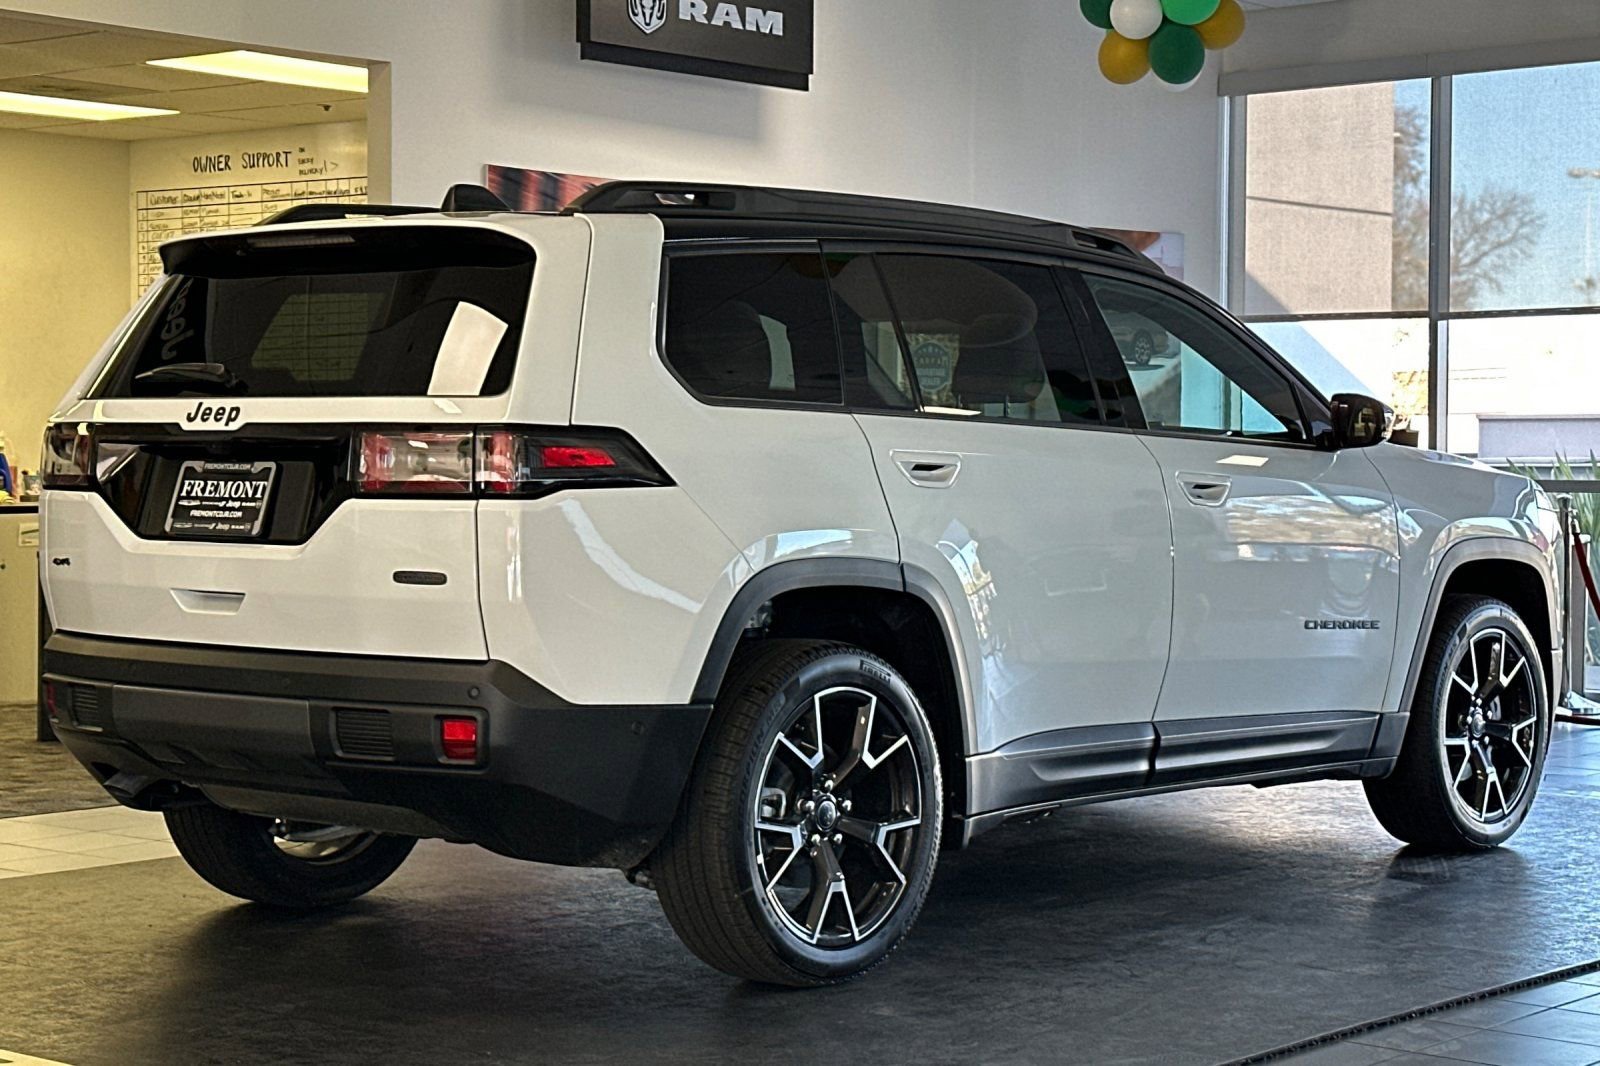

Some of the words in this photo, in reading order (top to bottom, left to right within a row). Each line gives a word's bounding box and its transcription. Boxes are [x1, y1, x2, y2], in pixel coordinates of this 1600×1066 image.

[678, 0, 783, 36] RAM
[192, 154, 232, 174] OWNER
[241, 150, 292, 170] SUPPORT
[186, 401, 241, 427] Jeep
[180, 480, 268, 498] FREMONT
[1304, 620, 1380, 630] CHEROKEE
